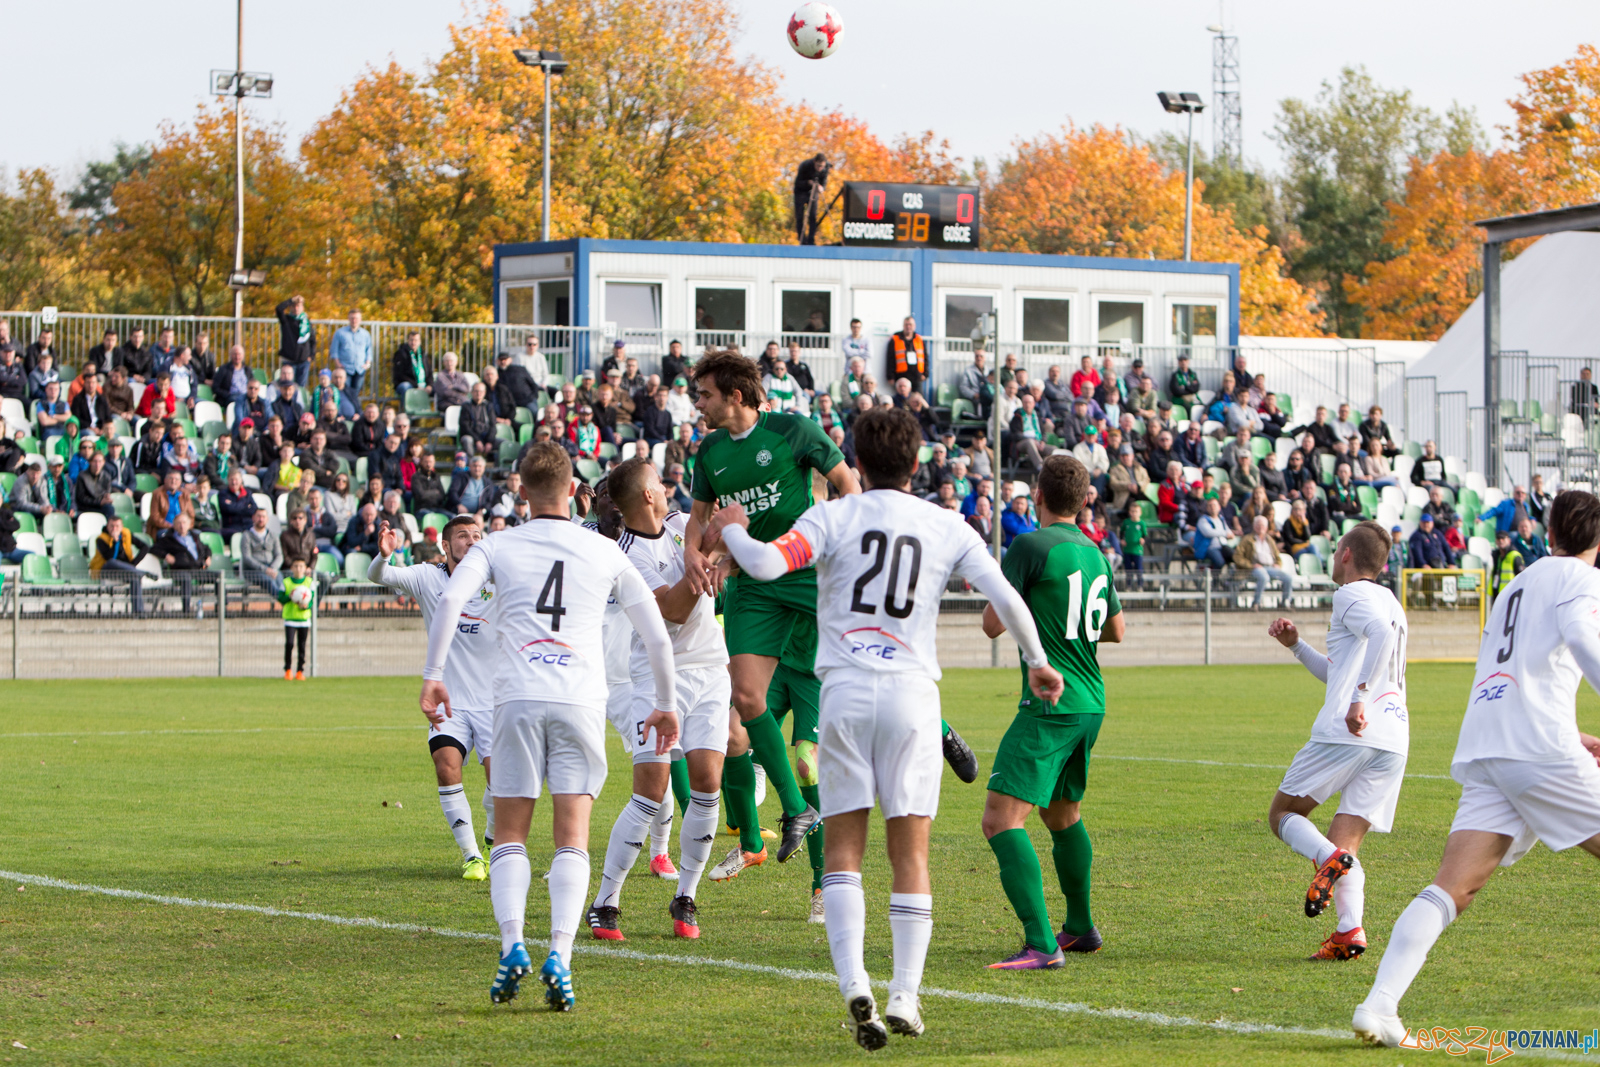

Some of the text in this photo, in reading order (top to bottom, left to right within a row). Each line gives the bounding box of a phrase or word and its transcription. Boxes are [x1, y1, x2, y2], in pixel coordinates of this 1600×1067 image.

[867, 190, 886, 220] 0
[903, 192, 923, 209] CZAS
[956, 193, 974, 223] 0
[844, 222, 894, 240] GOSPODARZE
[897, 212, 930, 242] 38
[720, 479, 780, 508] FAMILY
[851, 530, 922, 619] 20
[536, 560, 566, 632] 4
[1064, 569, 1108, 642] 16
[457, 623, 480, 634] GE
[1497, 588, 1523, 664] 9
[529, 651, 571, 666] PGE
[851, 641, 897, 659] PGE
[1474, 683, 1508, 705] PGE
